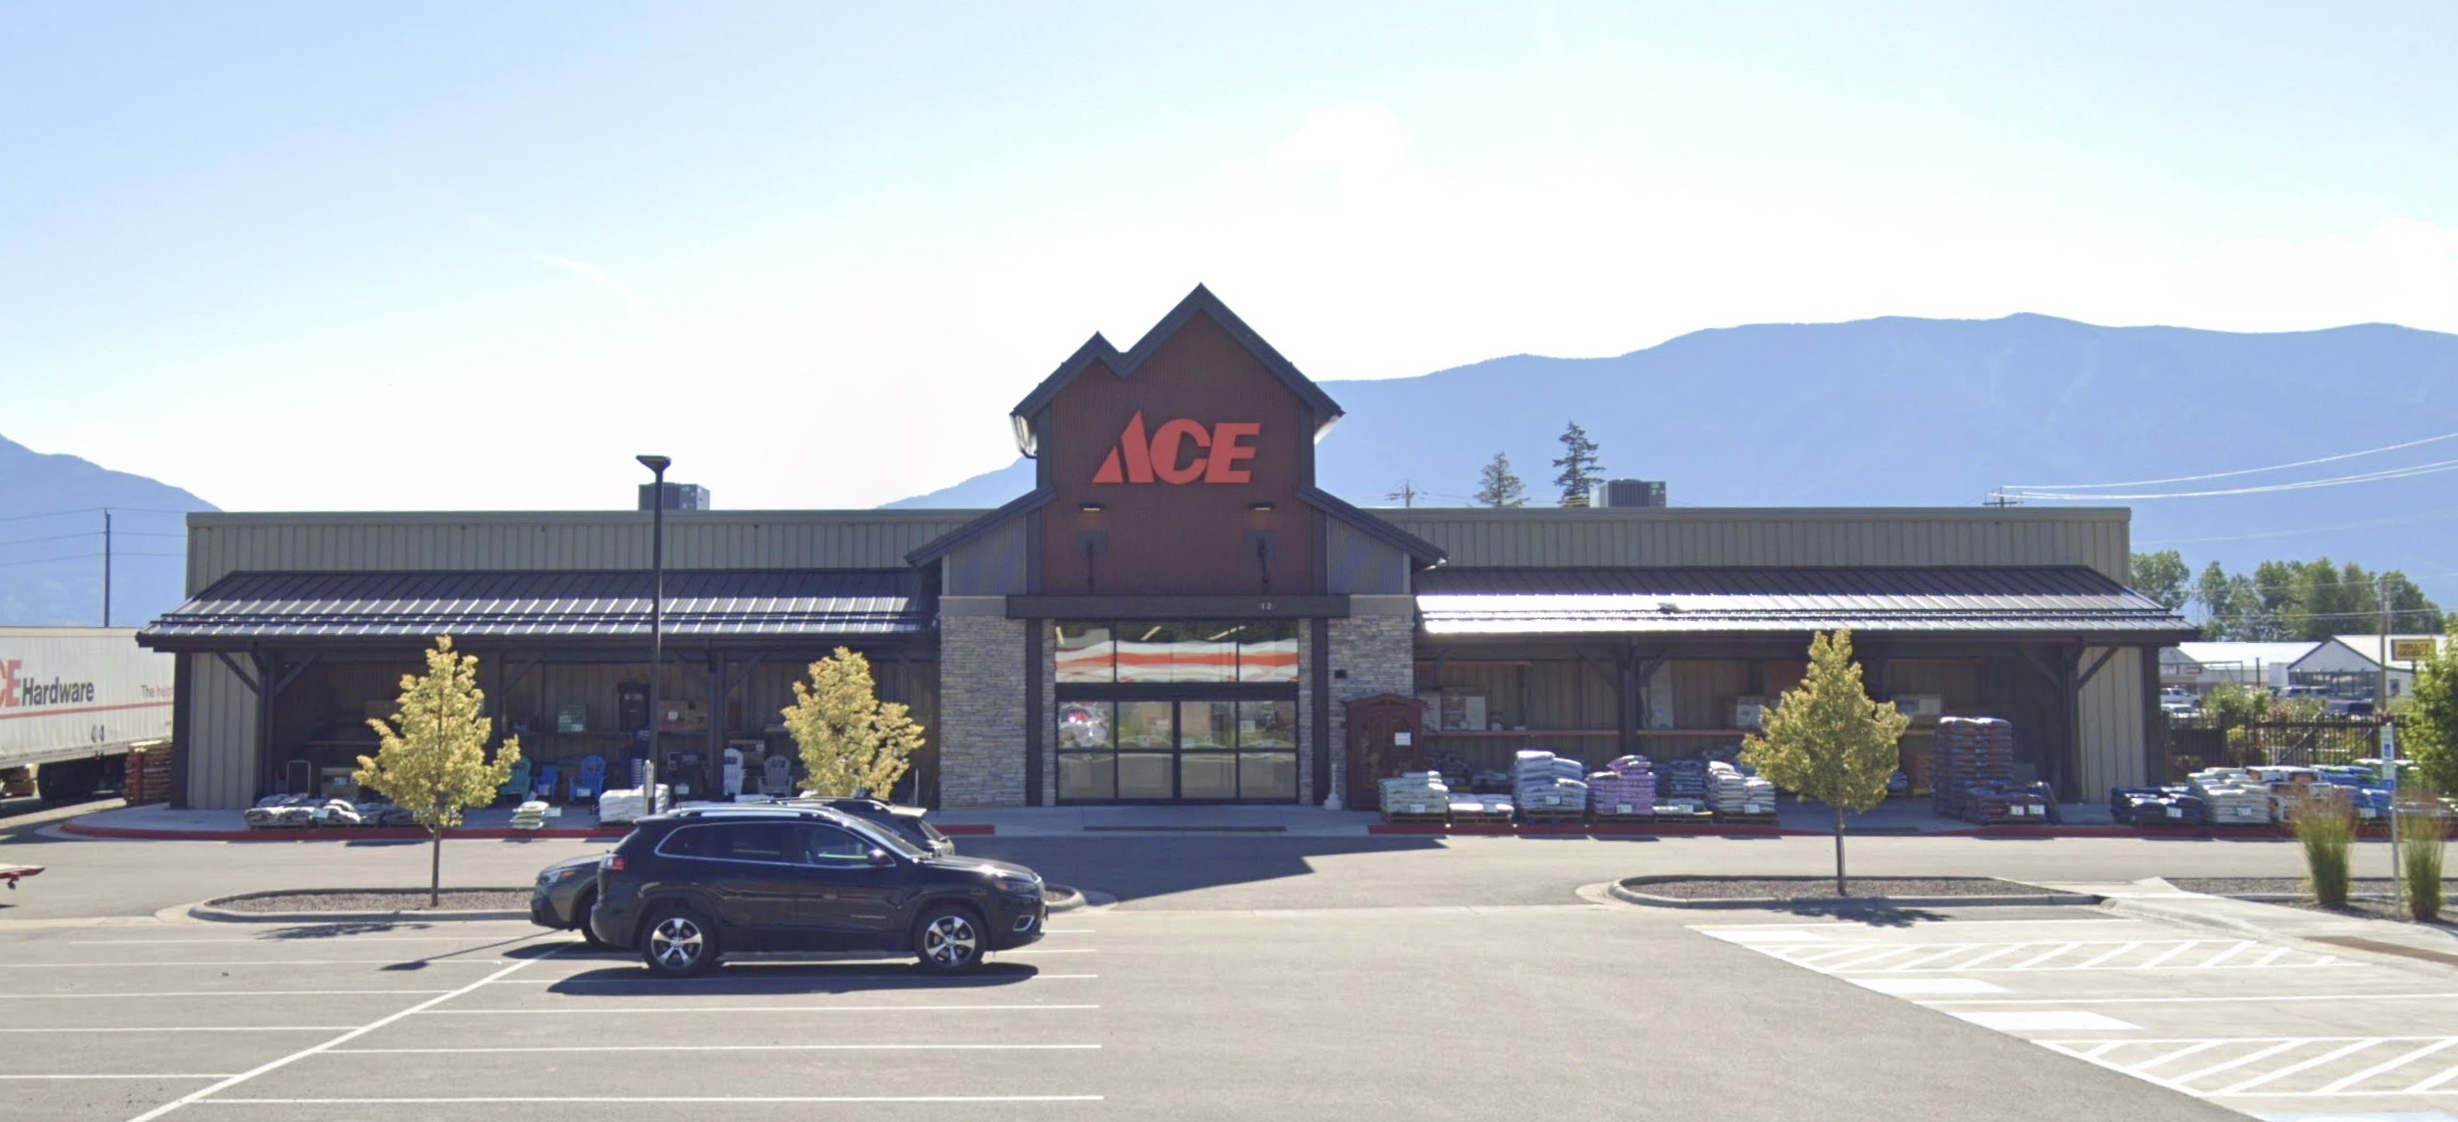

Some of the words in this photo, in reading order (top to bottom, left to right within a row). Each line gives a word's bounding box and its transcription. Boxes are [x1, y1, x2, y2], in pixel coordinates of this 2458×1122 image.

[1091, 409, 1261, 484] ACE
[22, 677, 94, 706] Hardware
[141, 684, 155, 698] The
